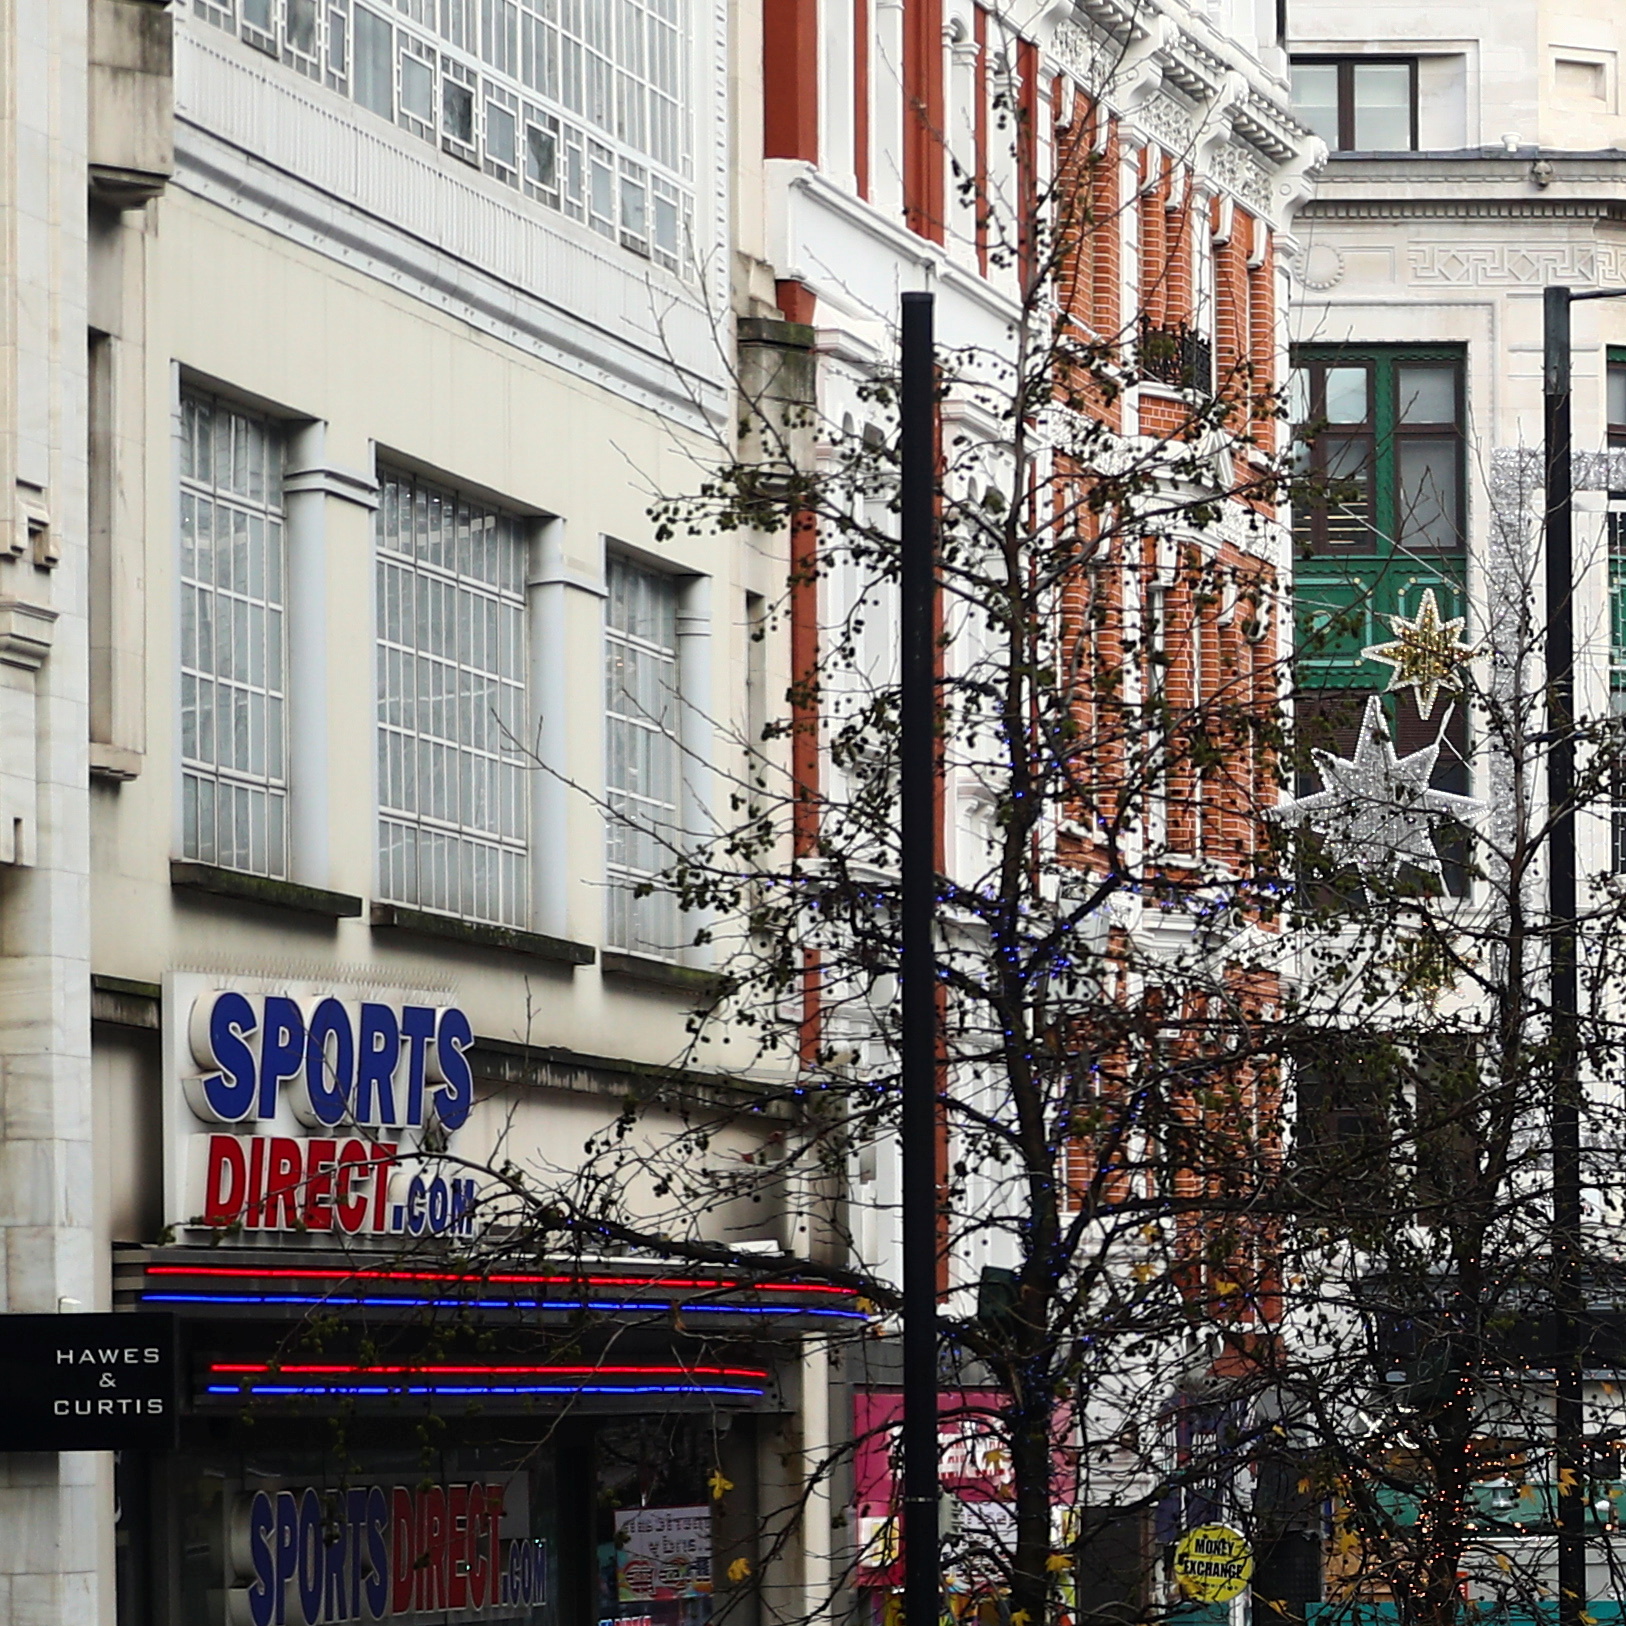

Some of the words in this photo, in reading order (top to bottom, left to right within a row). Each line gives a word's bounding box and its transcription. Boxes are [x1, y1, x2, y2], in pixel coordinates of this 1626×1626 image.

[200, 991, 475, 1132] SPORTS
[202, 1133, 475, 1238] DIRECT.COM
[56, 1348, 160, 1365] HAWES
[99, 1372, 117, 1388] &
[53, 1398, 163, 1416] CURTIS
[1195, 1538, 1234, 1556] MONEY
[1184, 1560, 1243, 1579] EXCHANGE
